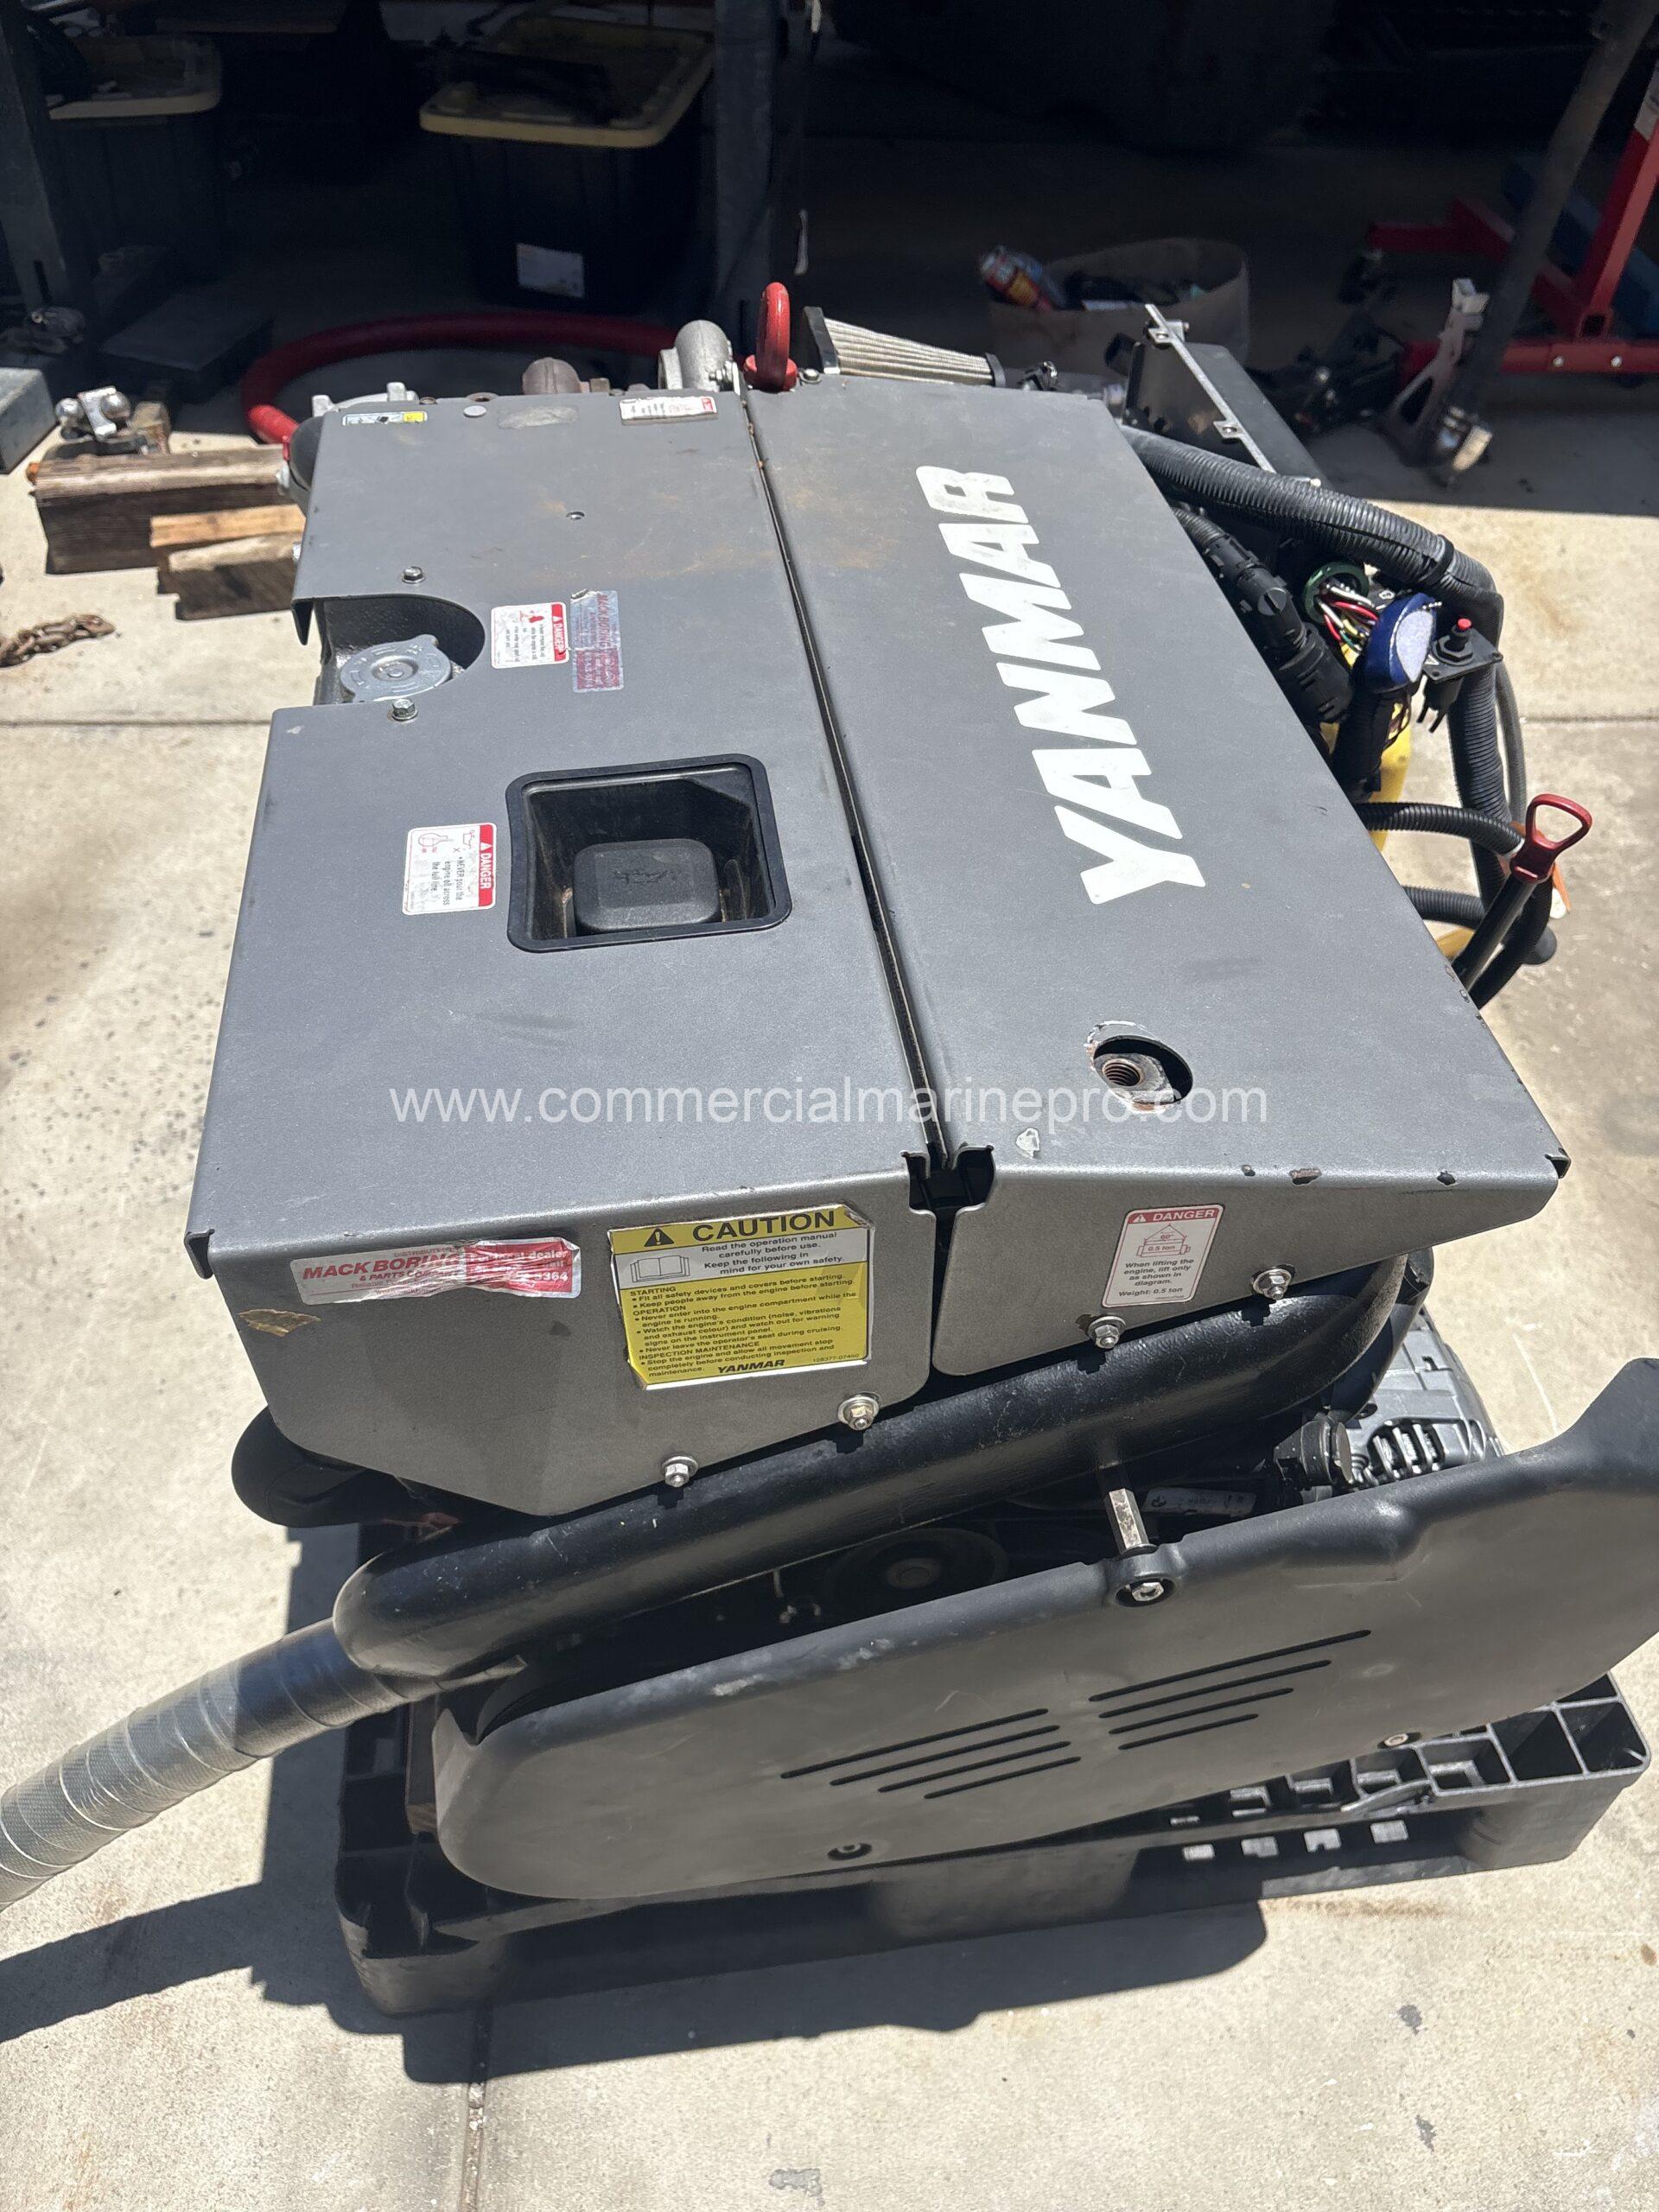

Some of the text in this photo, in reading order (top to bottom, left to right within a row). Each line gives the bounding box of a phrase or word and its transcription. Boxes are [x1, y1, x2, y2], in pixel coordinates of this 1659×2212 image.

[553, 622, 566, 652] DANGER
[916, 465, 1206, 905] YANMAR
[455, 859, 466, 878] NEVER
[480, 852, 493, 889] DANGER
[1152, 1210, 1215, 1222] DANGER
[692, 1211, 835, 1242] CAUTION
[749, 1236, 798, 1249] operation
[800, 1231, 837, 1243] manual
[704, 1260, 730, 1269] Keep
[732, 1257, 748, 1266] the
[751, 1252, 797, 1264] following
[719, 1248, 762, 1259] carefully
[765, 1244, 797, 1254] before
[302, 1261, 372, 1280] MACK
[720, 1266, 745, 1275] mind
[747, 1263, 760, 1272] for
[764, 1262, 787, 1271] your
[812, 1255, 845, 1265] safety.
[1123, 1267, 1156, 1275] engine,
[369, 1271, 404, 1281] PARTS
[630, 1286, 677, 1296] STARTING
[664, 1290, 691, 1299] safety
[694, 1287, 728, 1295] devices
[748, 1281, 777, 1289] covers
[664, 1297, 694, 1306] people
[696, 1294, 718, 1303] away
[759, 1286, 788, 1294] engine
[790, 1282, 817, 1291] before
[632, 1305, 687, 1317] OPERATION
[728, 1303, 758, 1312] engine
[760, 1296, 817, 1306] compartment
[642, 1326, 671, 1335] Watch
[688, 1320, 724, 1330] engine's
[726, 1314, 766, 1325] condition
[798, 1306, 842, 1315] vibrations
[642, 1319, 671, 1329] engine
[662, 1330, 696, 1338] exhaust
[698, 1325, 729, 1335] colour)
[748, 1319, 774, 1328] watch
[805, 1312, 841, 1322] warning
[672, 1342, 695, 1351] leave
[712, 1335, 755, 1345] operator's
[777, 1328, 804, 1338] during
[699, 1329, 746, 1340] instrument
[639, 1341, 760, 1360] INSPECTION MAINTENANCE
[646, 1357, 667, 1366] Stop
[684, 1351, 714, 1361] engine
[769, 1340, 813, 1351] movement
[814, 1338, 834, 1346] stop
[647, 1361, 694, 1371] completely
[696, 1357, 723, 1366] before
[724, 1350, 772, 1363] conducting
[773, 1346, 817, 1357] inspection
[648, 1366, 705, 1377] maintenance.
[717, 1359, 785, 1373] YANMAR
